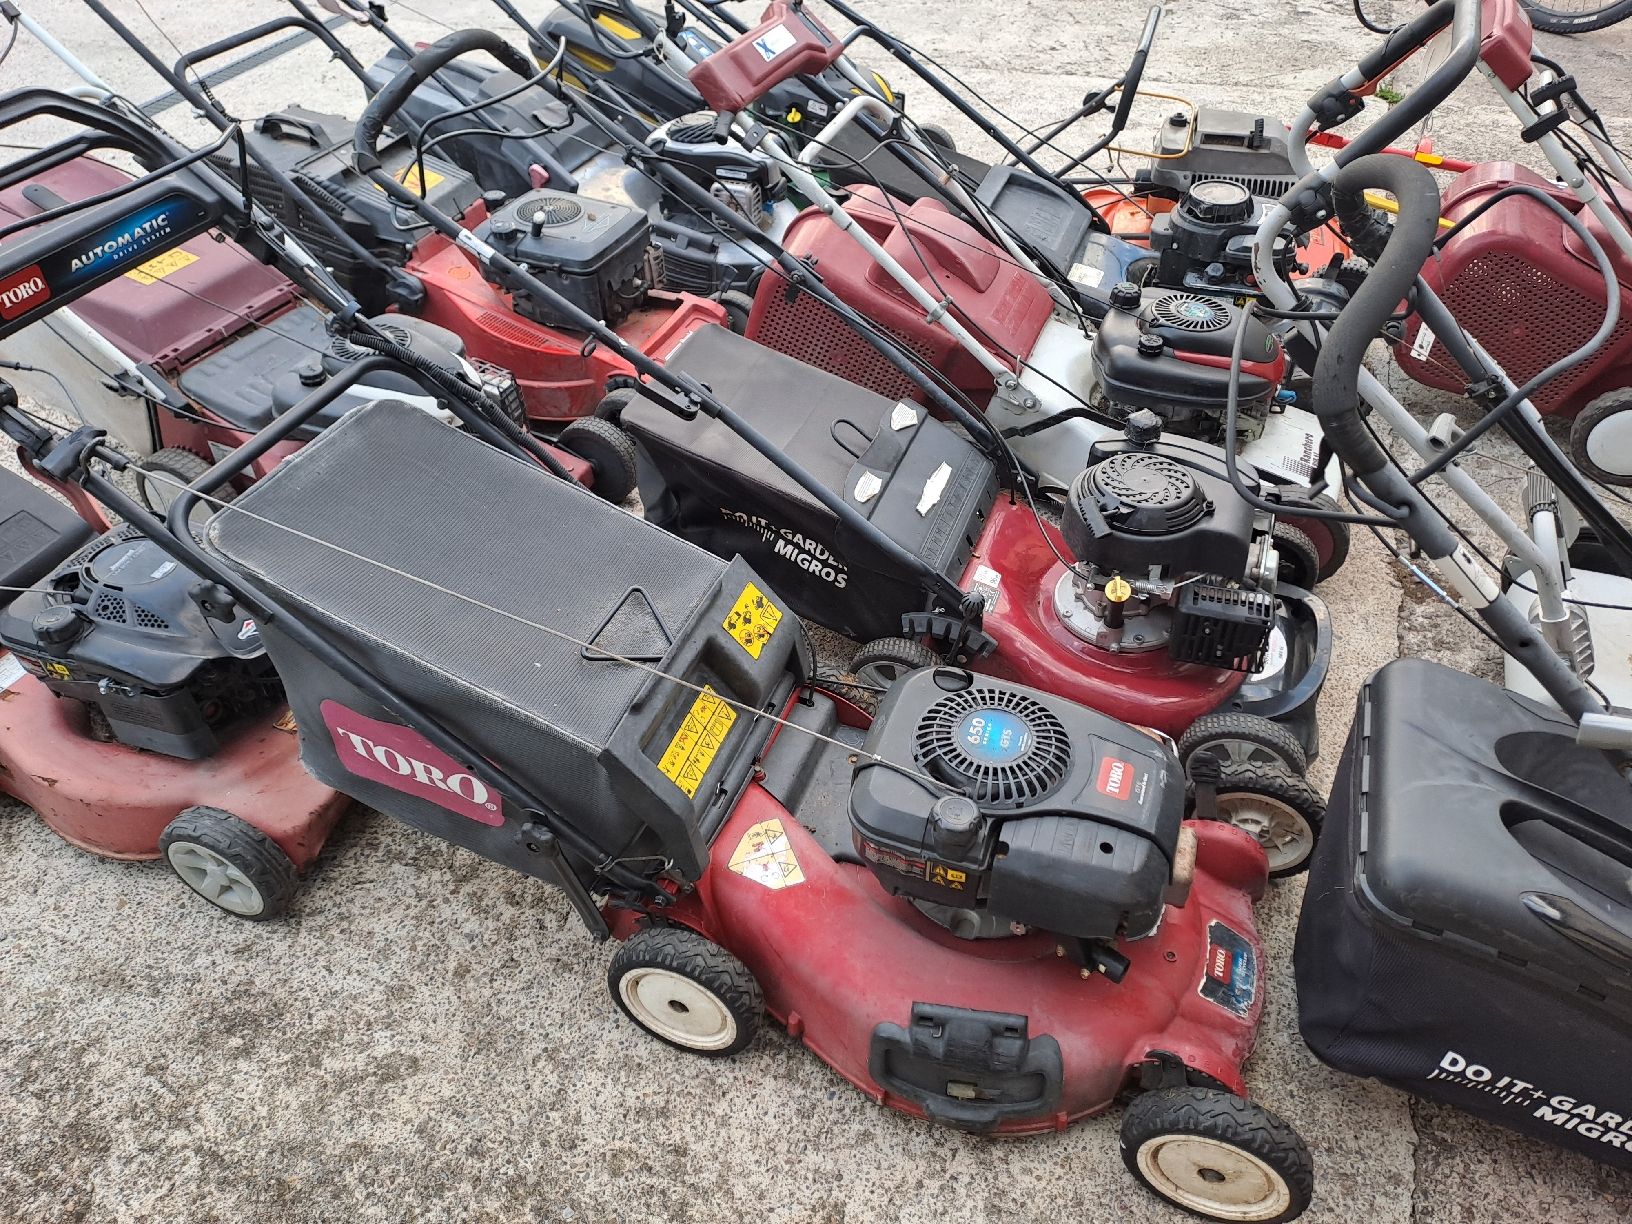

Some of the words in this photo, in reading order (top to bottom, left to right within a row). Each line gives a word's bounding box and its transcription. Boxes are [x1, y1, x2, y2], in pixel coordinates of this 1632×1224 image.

[71, 213, 169, 273] AUTOMATIC
[0, 276, 45, 309] TORO
[773, 538, 848, 589] MIGROS
[780, 528, 848, 572] GARD
[967, 717, 986, 745] 650
[336, 726, 489, 804] TORO
[1105, 761, 1125, 794] TORO
[1214, 949, 1226, 977] TORO
[1439, 1051, 1492, 1082] DO
